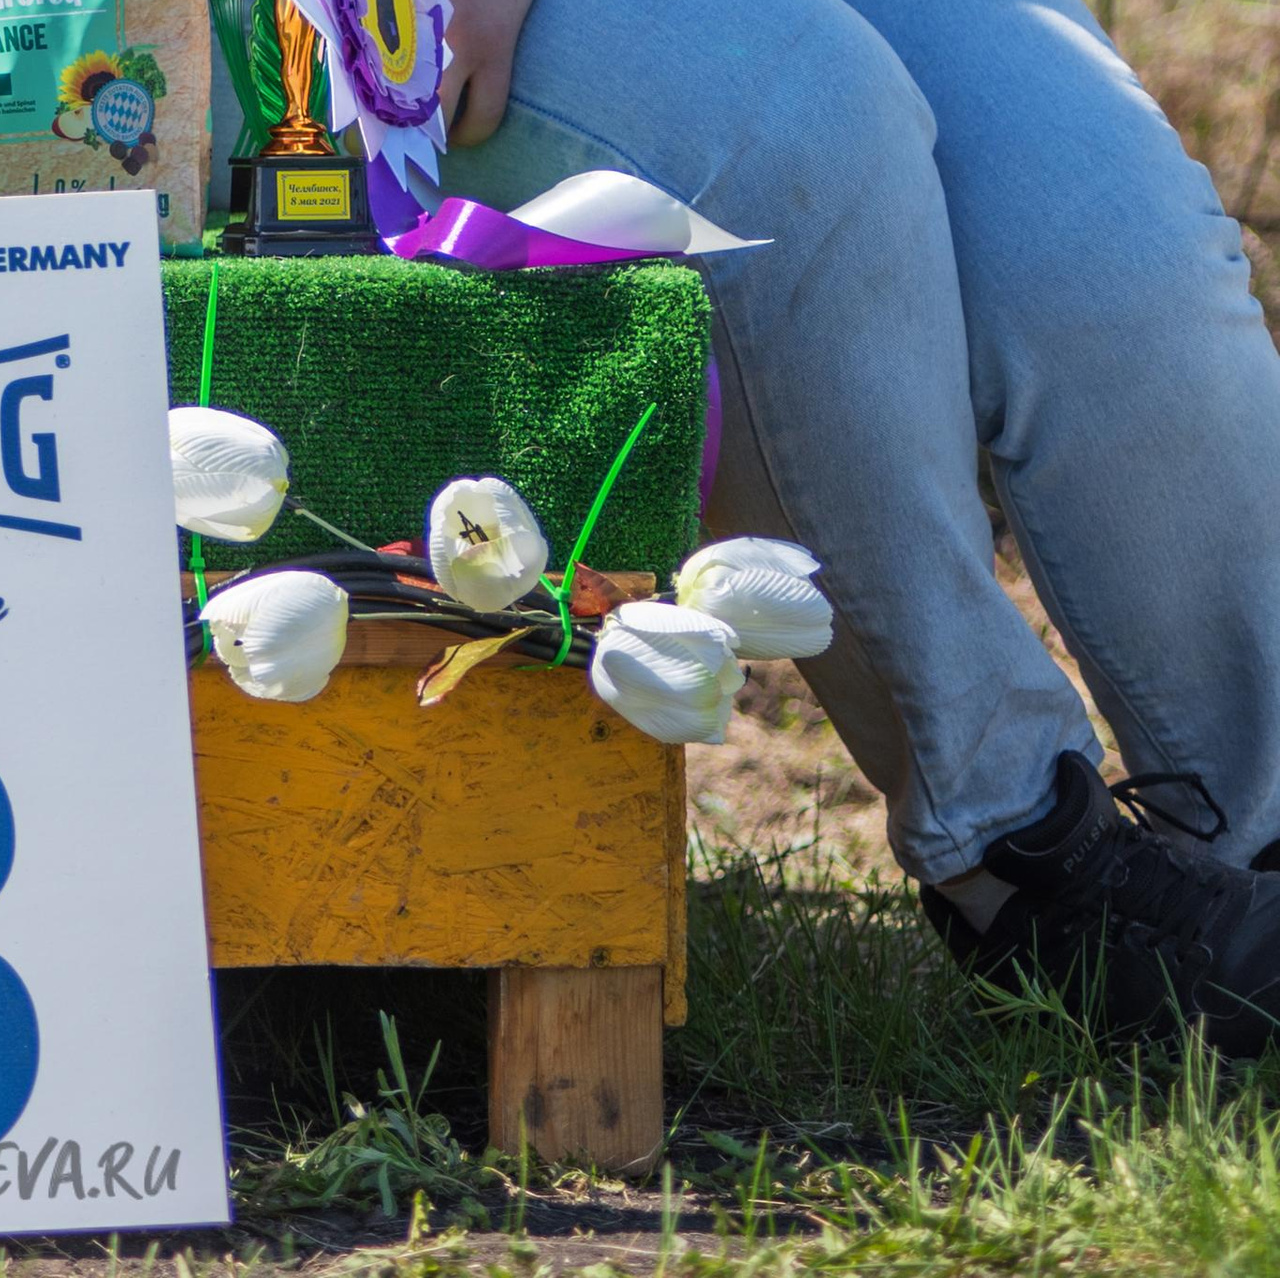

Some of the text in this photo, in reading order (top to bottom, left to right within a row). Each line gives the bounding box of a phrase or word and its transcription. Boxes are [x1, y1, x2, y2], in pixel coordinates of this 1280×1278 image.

[289, 184, 341, 193] Челябинск,
[291, 197, 340, 206] 8 мая 2021
[1063, 812, 1109, 874] PULSE
